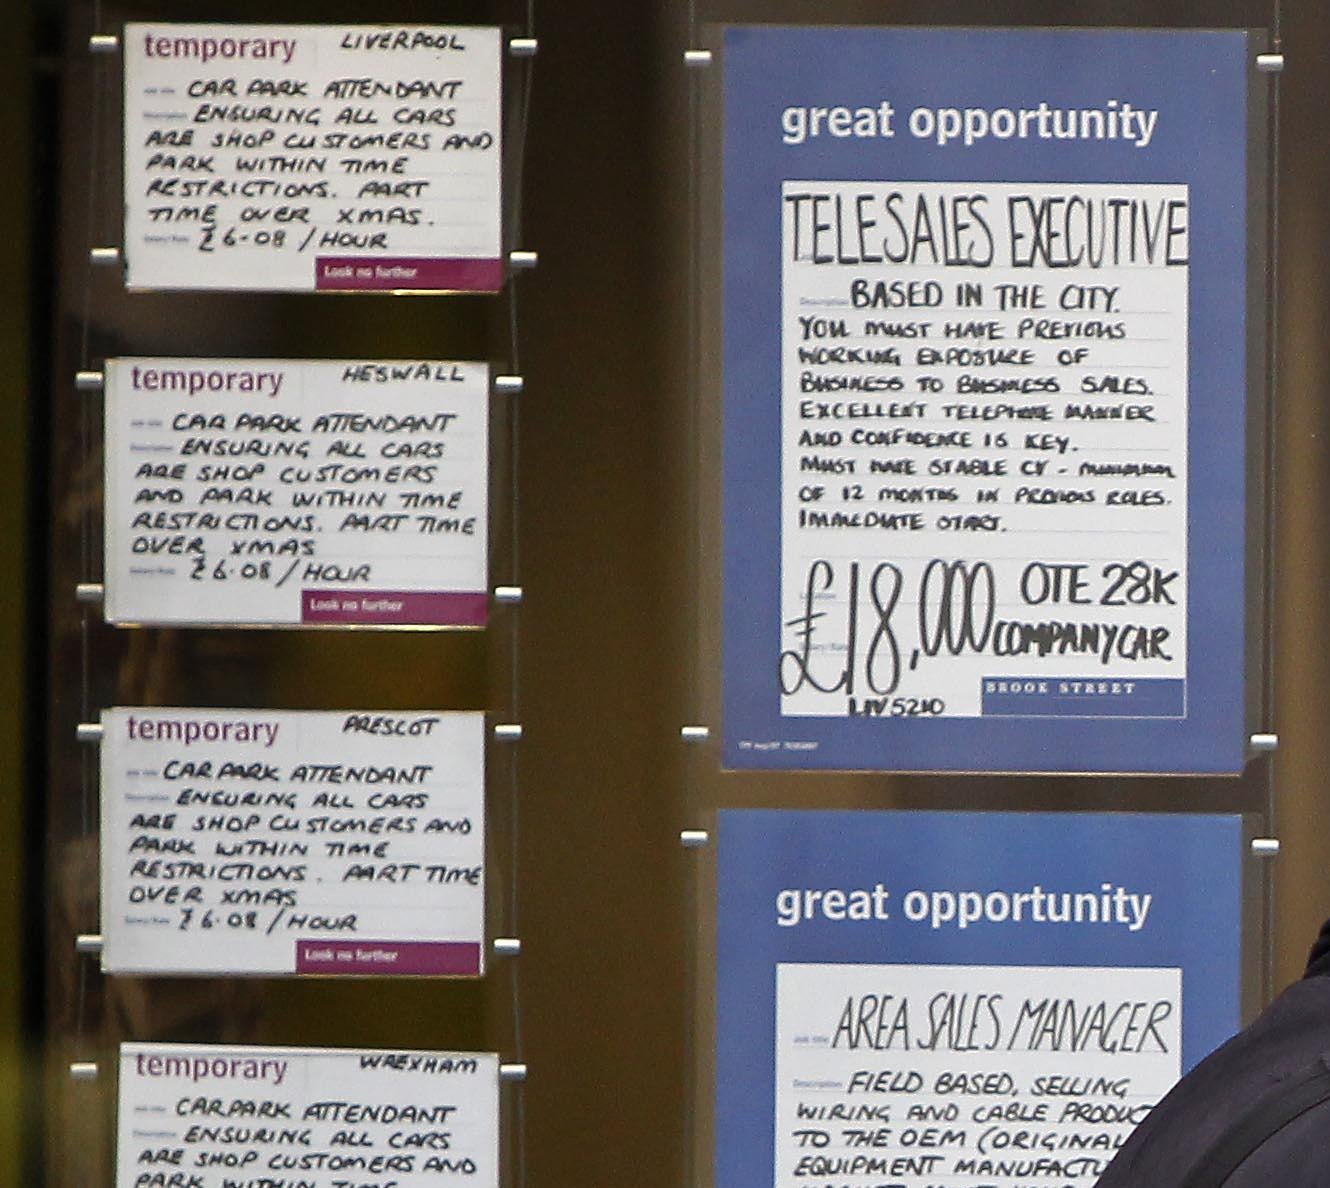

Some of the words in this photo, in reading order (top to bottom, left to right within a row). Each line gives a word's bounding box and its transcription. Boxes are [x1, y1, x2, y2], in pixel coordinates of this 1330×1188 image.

[145, 34, 296, 63] temporary
[341, 31, 465, 50] LIVERPOOL
[188, 79, 237, 98] CAR
[247, 80, 306, 96] PARK
[324, 79, 462, 99] ATTENDANT
[193, 104, 320, 126] ENSURING
[335, 108, 377, 124] ALL
[393, 108, 455, 127] CARS
[783, 102, 894, 143] great
[910, 101, 1157, 147] opportunity
[786, 192, 995, 269] TELESALES
[1009, 194, 1189, 269] EXECUTIVE
[851, 280, 942, 308] BASED
[955, 280, 986, 310] IN
[994, 285, 1045, 311] THE
[1060, 285, 1119, 313] CITY.
[132, 367, 282, 397] temporary
[342, 363, 468, 382] HESWALL
[779, 559, 995, 696] £18,000
[1021, 562, 1092, 605] OTE
[1100, 561, 1179, 606] 28K
[128, 716, 278, 747] temporary
[343, 715, 440, 736] PRESCOT
[777, 885, 888, 926] great
[904, 884, 1151, 930] opportunity
[832, 995, 909, 1051] AREA
[917, 992, 1002, 1051] SALES
[1007, 999, 1172, 1054] MANAGER
[136, 1053, 287, 1085] temporary
[848, 1071, 923, 1093] FIELD
[934, 1073, 1018, 1096] BASED,
[1031, 1076, 1130, 1099] SELLING
